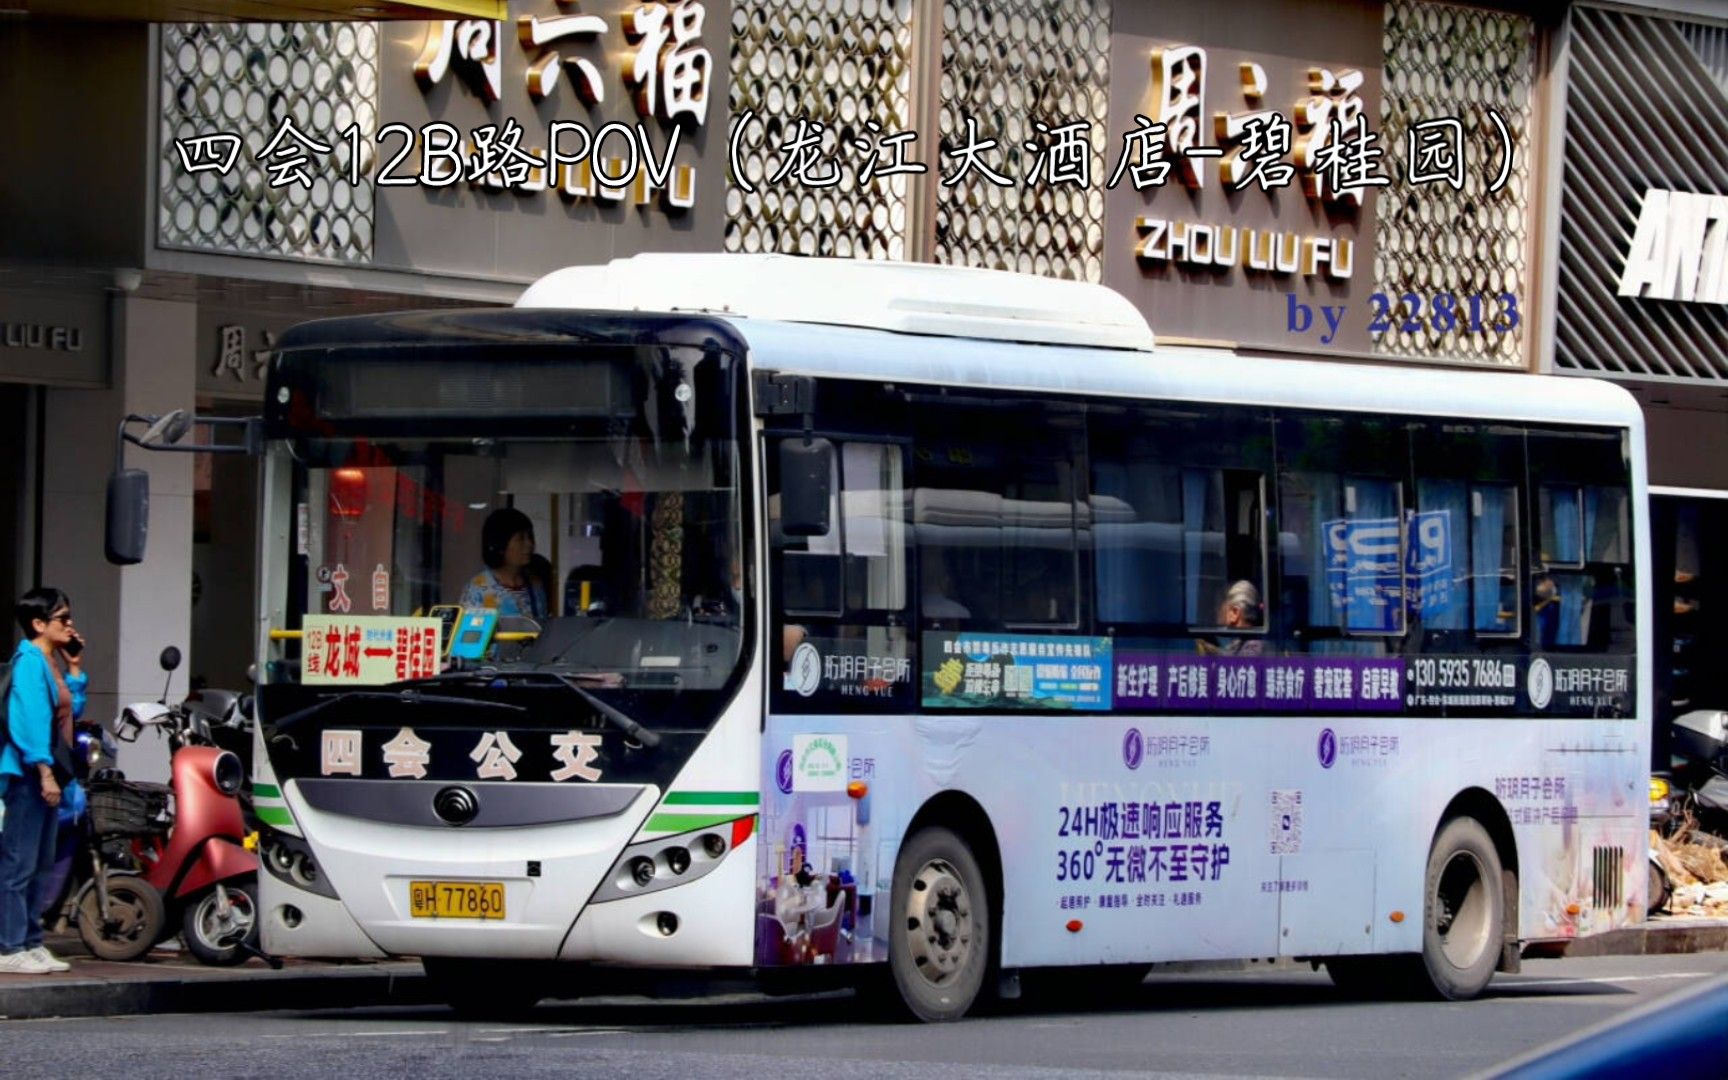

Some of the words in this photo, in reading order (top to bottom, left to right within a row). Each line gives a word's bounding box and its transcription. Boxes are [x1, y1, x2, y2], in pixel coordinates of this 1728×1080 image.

[1141, 218, 1237, 267] ZHOU
[1249, 226, 1300, 273] LIU
[1311, 237, 1354, 279] FU
[6, 324, 42, 347] LIU
[52, 327, 83, 350] FU
[1117, 665, 1158, 697] 新生护理
[1168, 665, 1208, 698] 产后修复
[1415, 659, 1436, 686] 130
[1439, 660, 1470, 687] 5935
[1473, 660, 1502, 687] 7686
[841, 684, 869, 697] HENG
[873, 686, 893, 698] YUE
[321, 727, 602, 782] 四会公交
[1058, 800, 1224, 840] 24H极速响应服务
